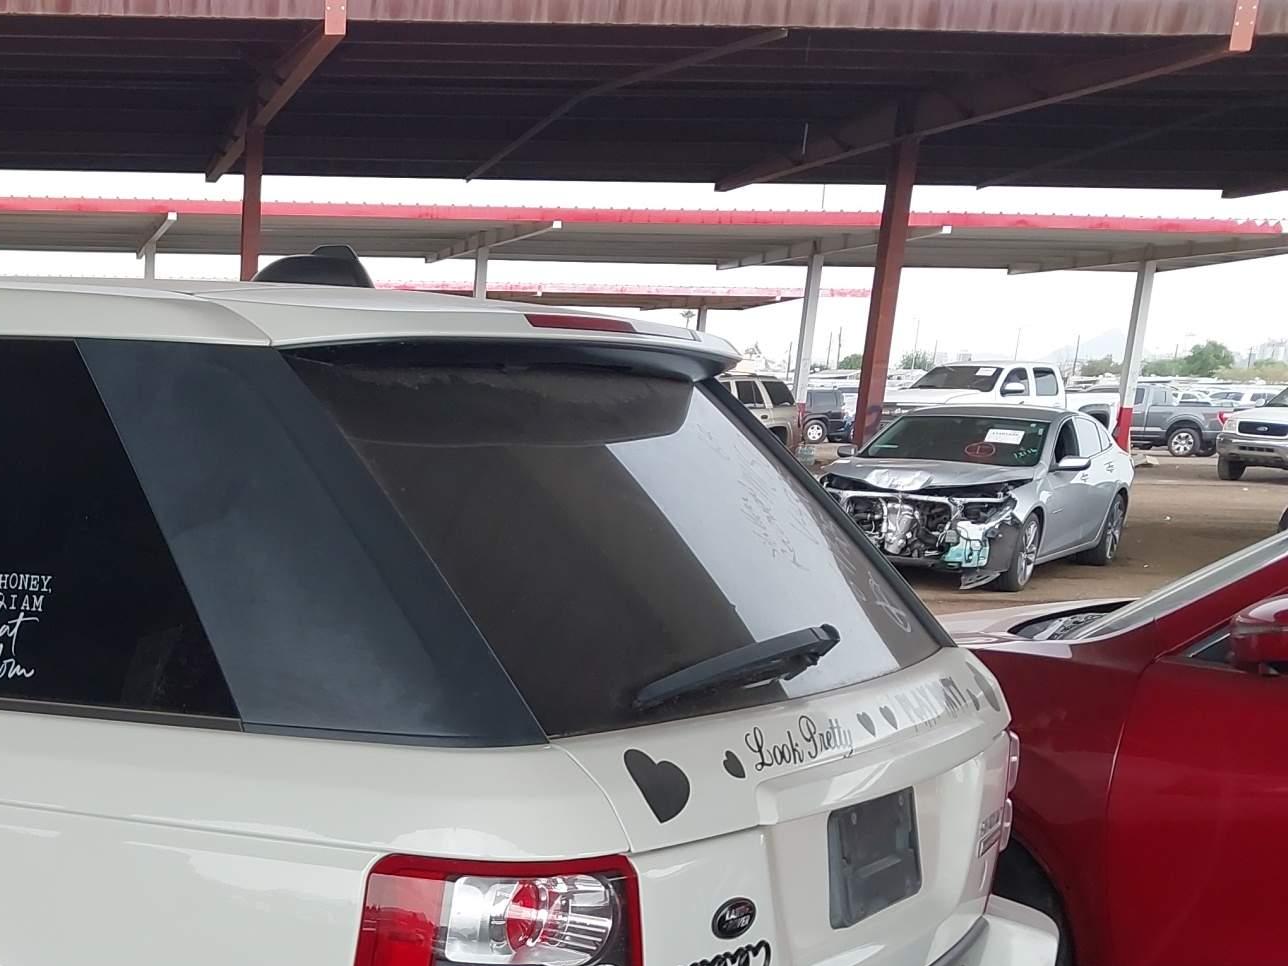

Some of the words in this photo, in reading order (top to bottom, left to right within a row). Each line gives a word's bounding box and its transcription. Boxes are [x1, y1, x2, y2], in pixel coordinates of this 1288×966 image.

[9, 594, 17, 610] I
[20, 594, 45, 612] AM
[744, 726, 805, 772] Look
[798, 715, 854, 760] Pretty
